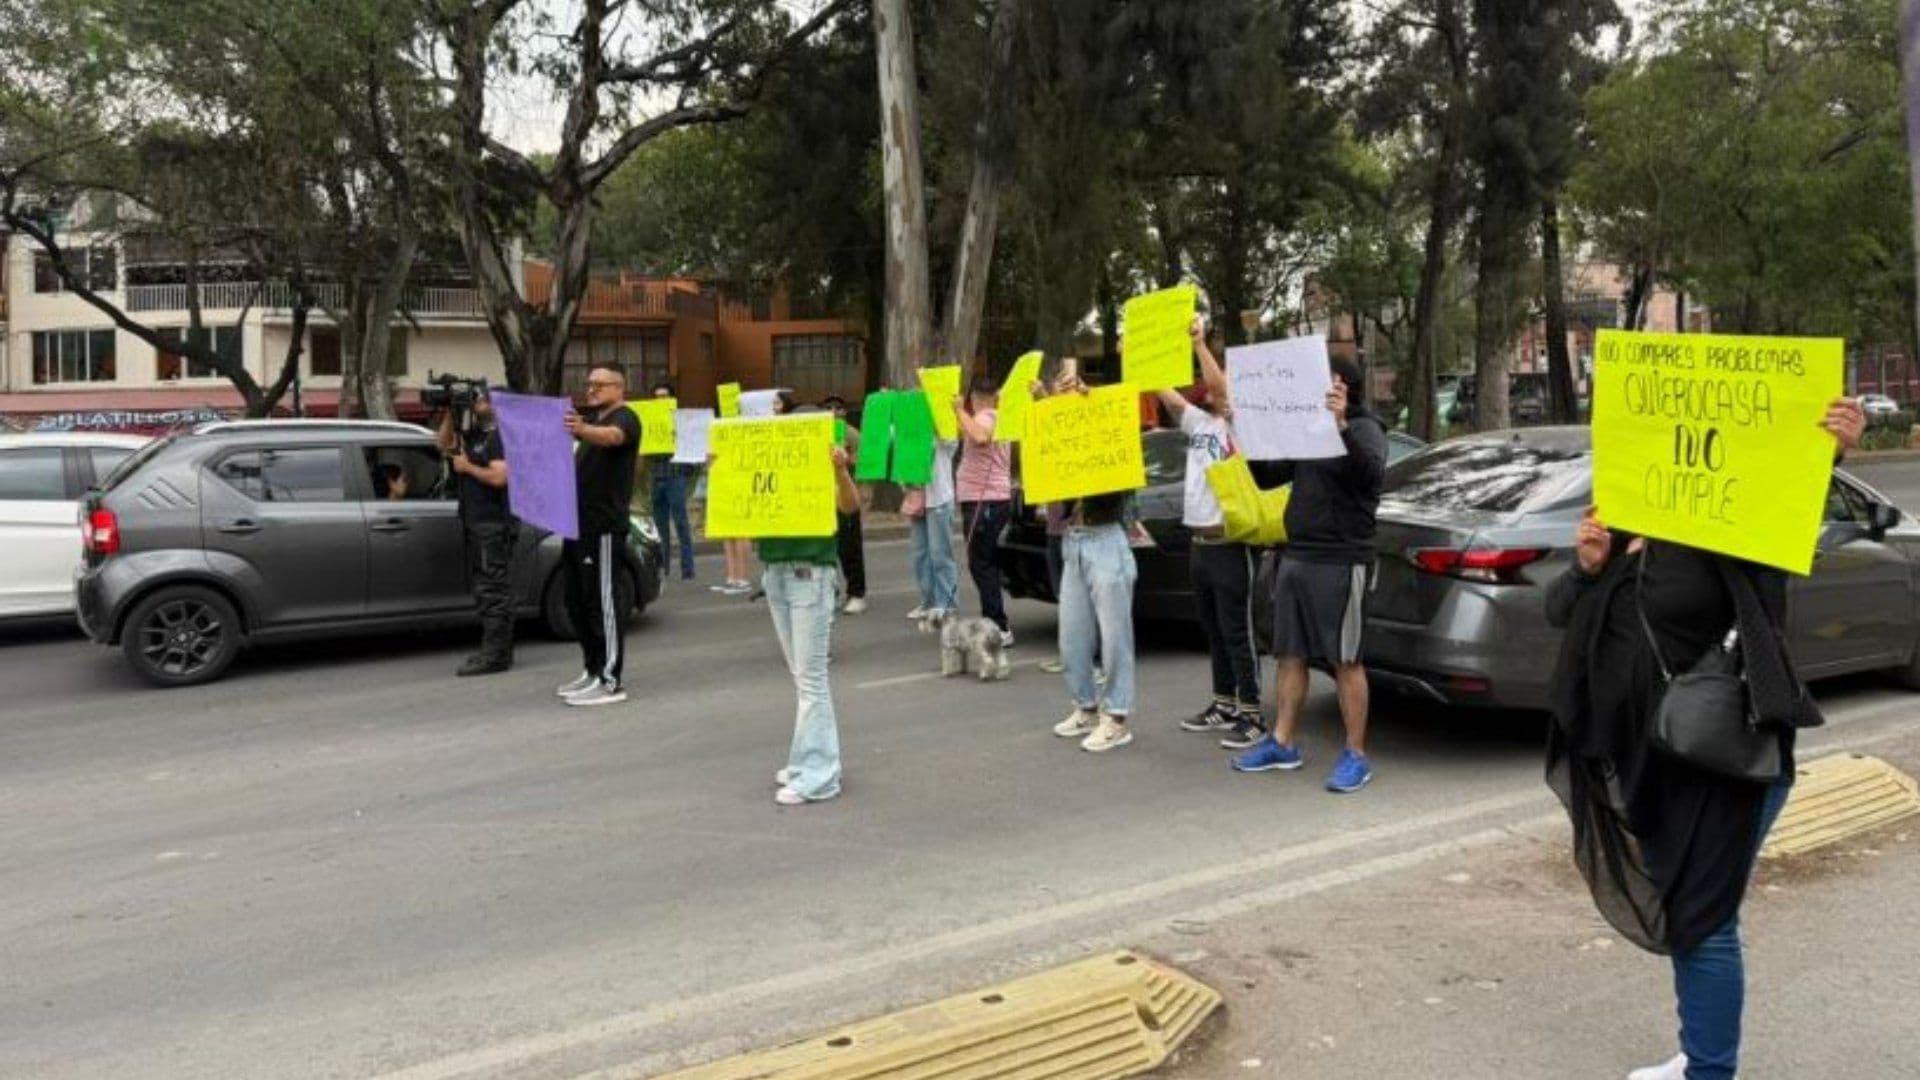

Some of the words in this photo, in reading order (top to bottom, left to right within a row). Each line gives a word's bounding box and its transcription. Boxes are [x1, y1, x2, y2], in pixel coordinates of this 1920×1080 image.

[1600, 340, 1620, 363] NO
[1625, 341, 1696, 370] COMPRES
[1706, 344, 1806, 377] PROBLEMAS
[1674, 424, 1726, 473] NO
[752, 470, 779, 494] NO
[1644, 463, 1738, 525] CUMPLE
